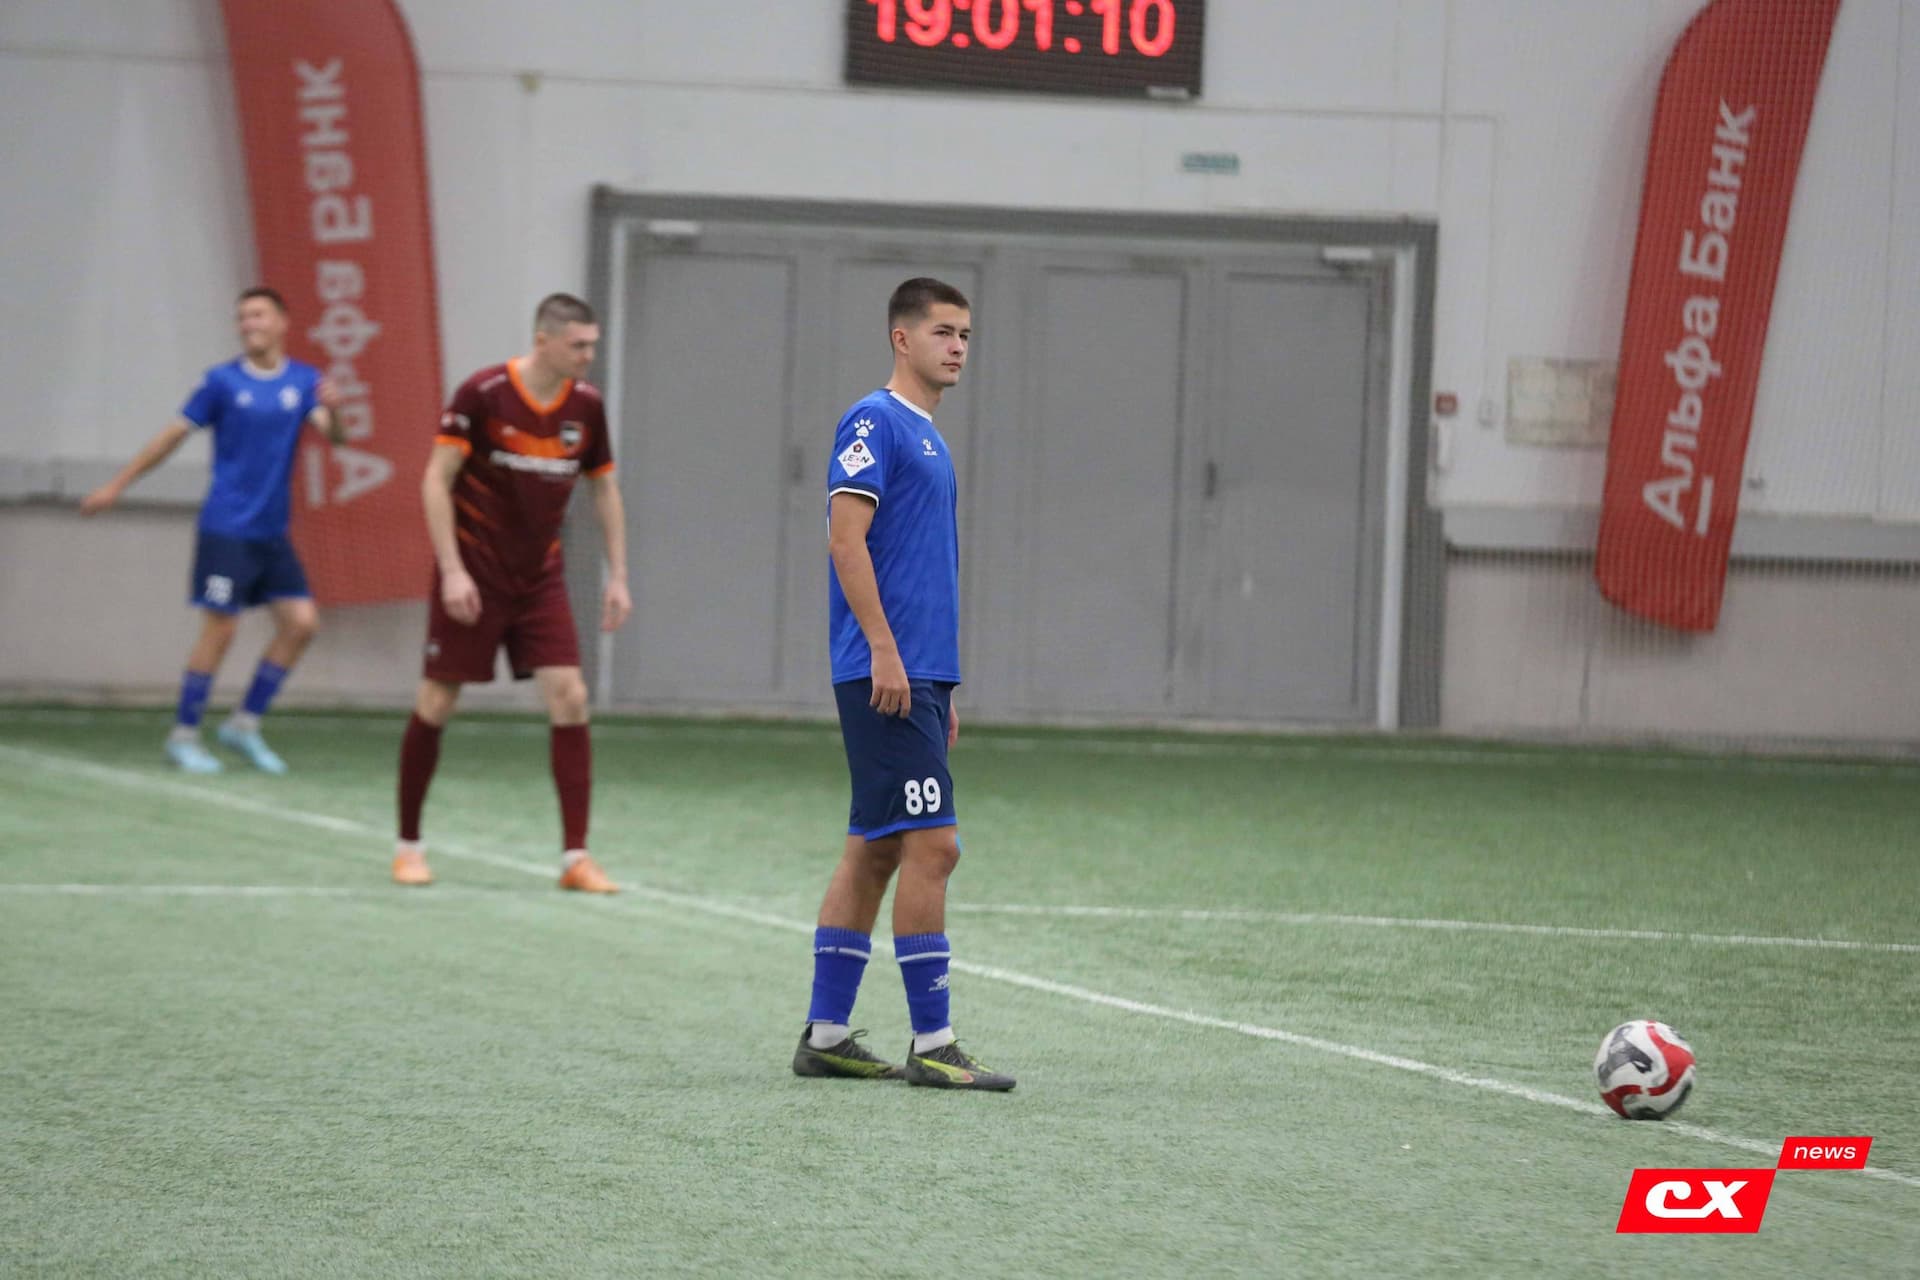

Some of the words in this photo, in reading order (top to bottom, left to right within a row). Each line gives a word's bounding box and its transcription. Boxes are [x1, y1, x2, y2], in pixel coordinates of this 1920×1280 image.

[1678, 97, 1757, 282] Банк
[1641, 295, 1722, 536] Альфа
[904, 777, 941, 815] 89
